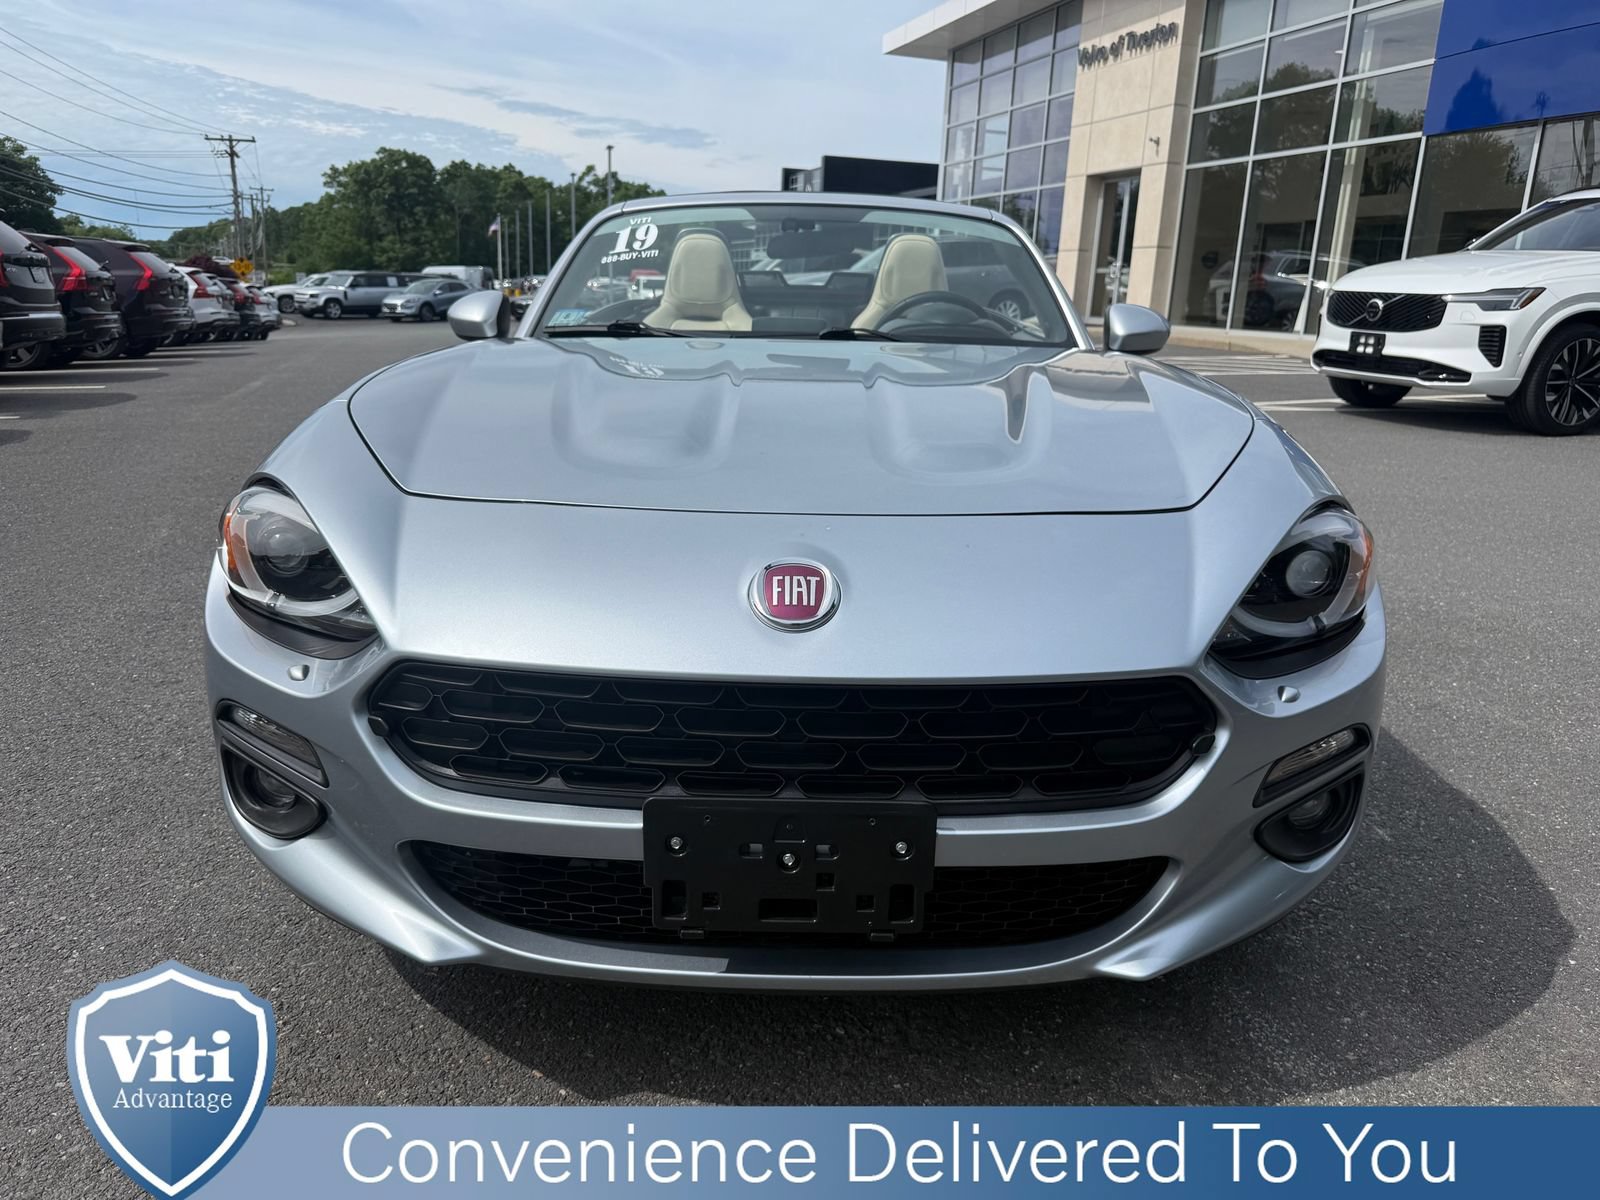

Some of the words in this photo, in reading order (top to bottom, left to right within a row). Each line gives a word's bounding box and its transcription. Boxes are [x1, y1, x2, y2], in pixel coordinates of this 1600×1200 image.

[1109, 35, 1125, 59] of
[630, 217, 652, 225] VITI
[609, 223, 658, 254] 19
[772, 575, 820, 606] FIAT
